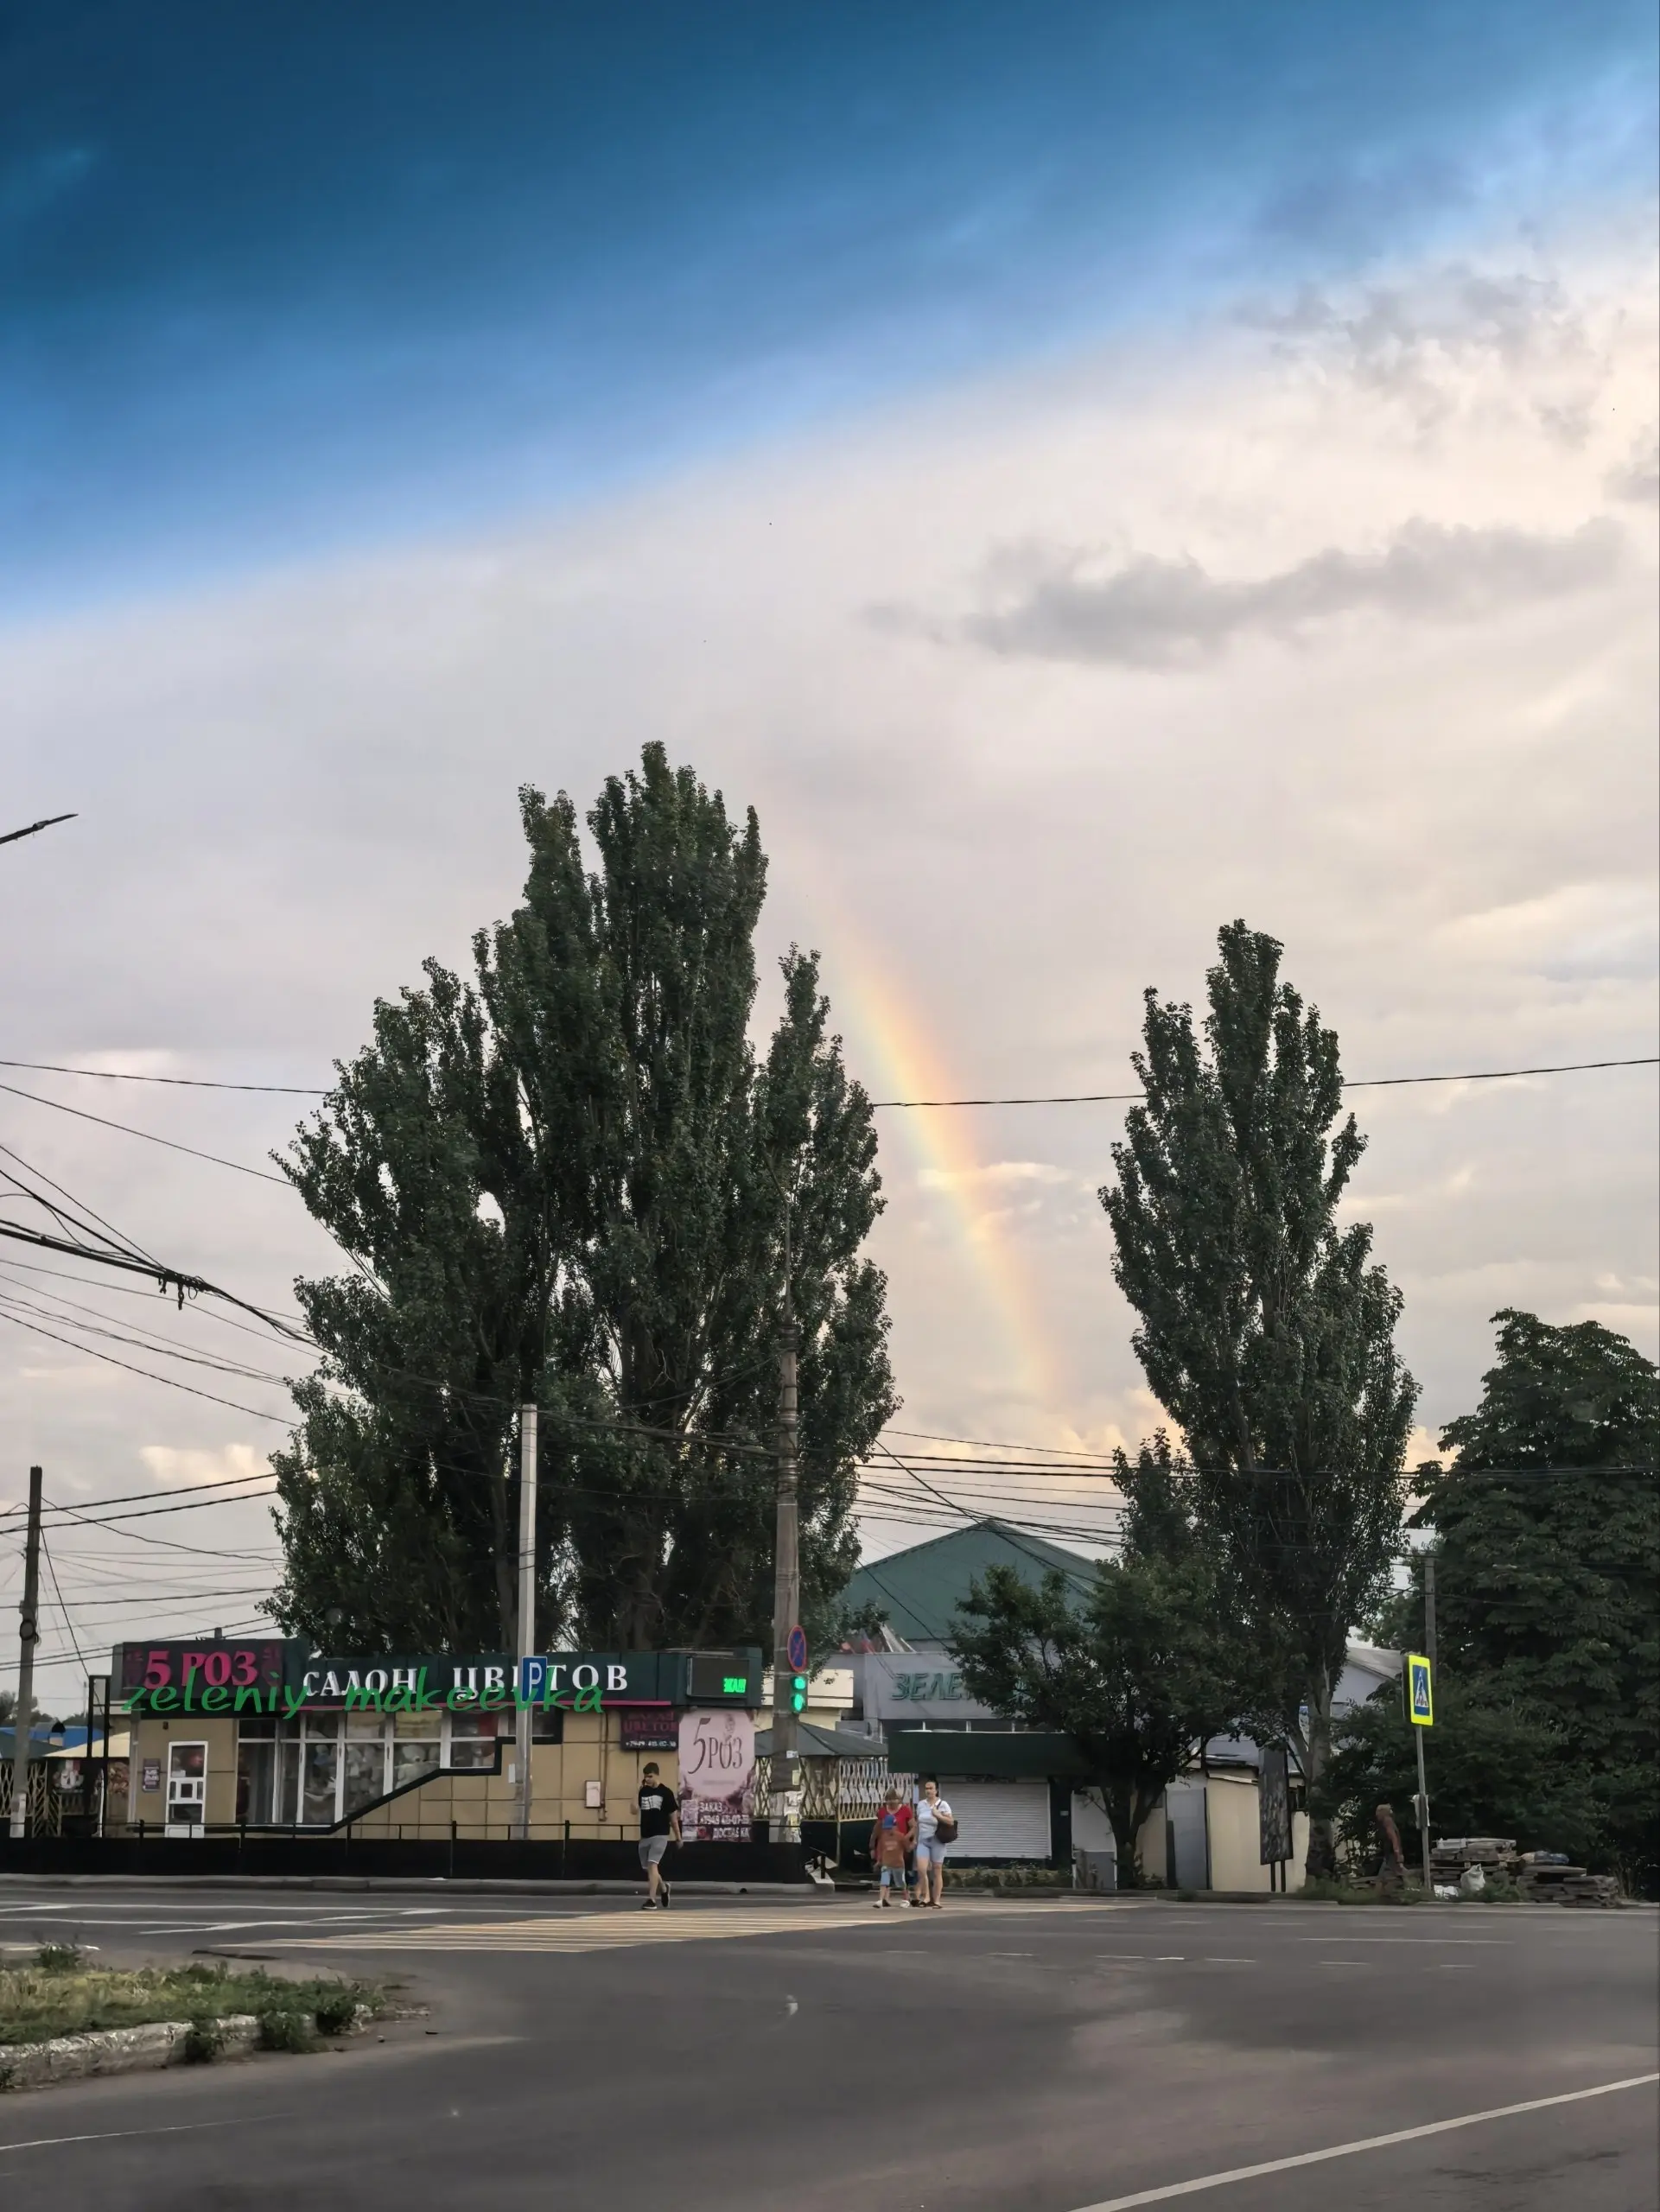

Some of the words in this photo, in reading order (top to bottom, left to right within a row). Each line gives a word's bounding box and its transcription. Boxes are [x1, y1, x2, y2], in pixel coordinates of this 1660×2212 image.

[144, 1650, 171, 1689] 5
[181, 1651, 258, 1686] РОЗ
[303, 1668, 418, 1696] САЛОН
[453, 1664, 628, 1700] ЦВТОВ
[891, 1671, 973, 1701] ЗЕЛЕ
